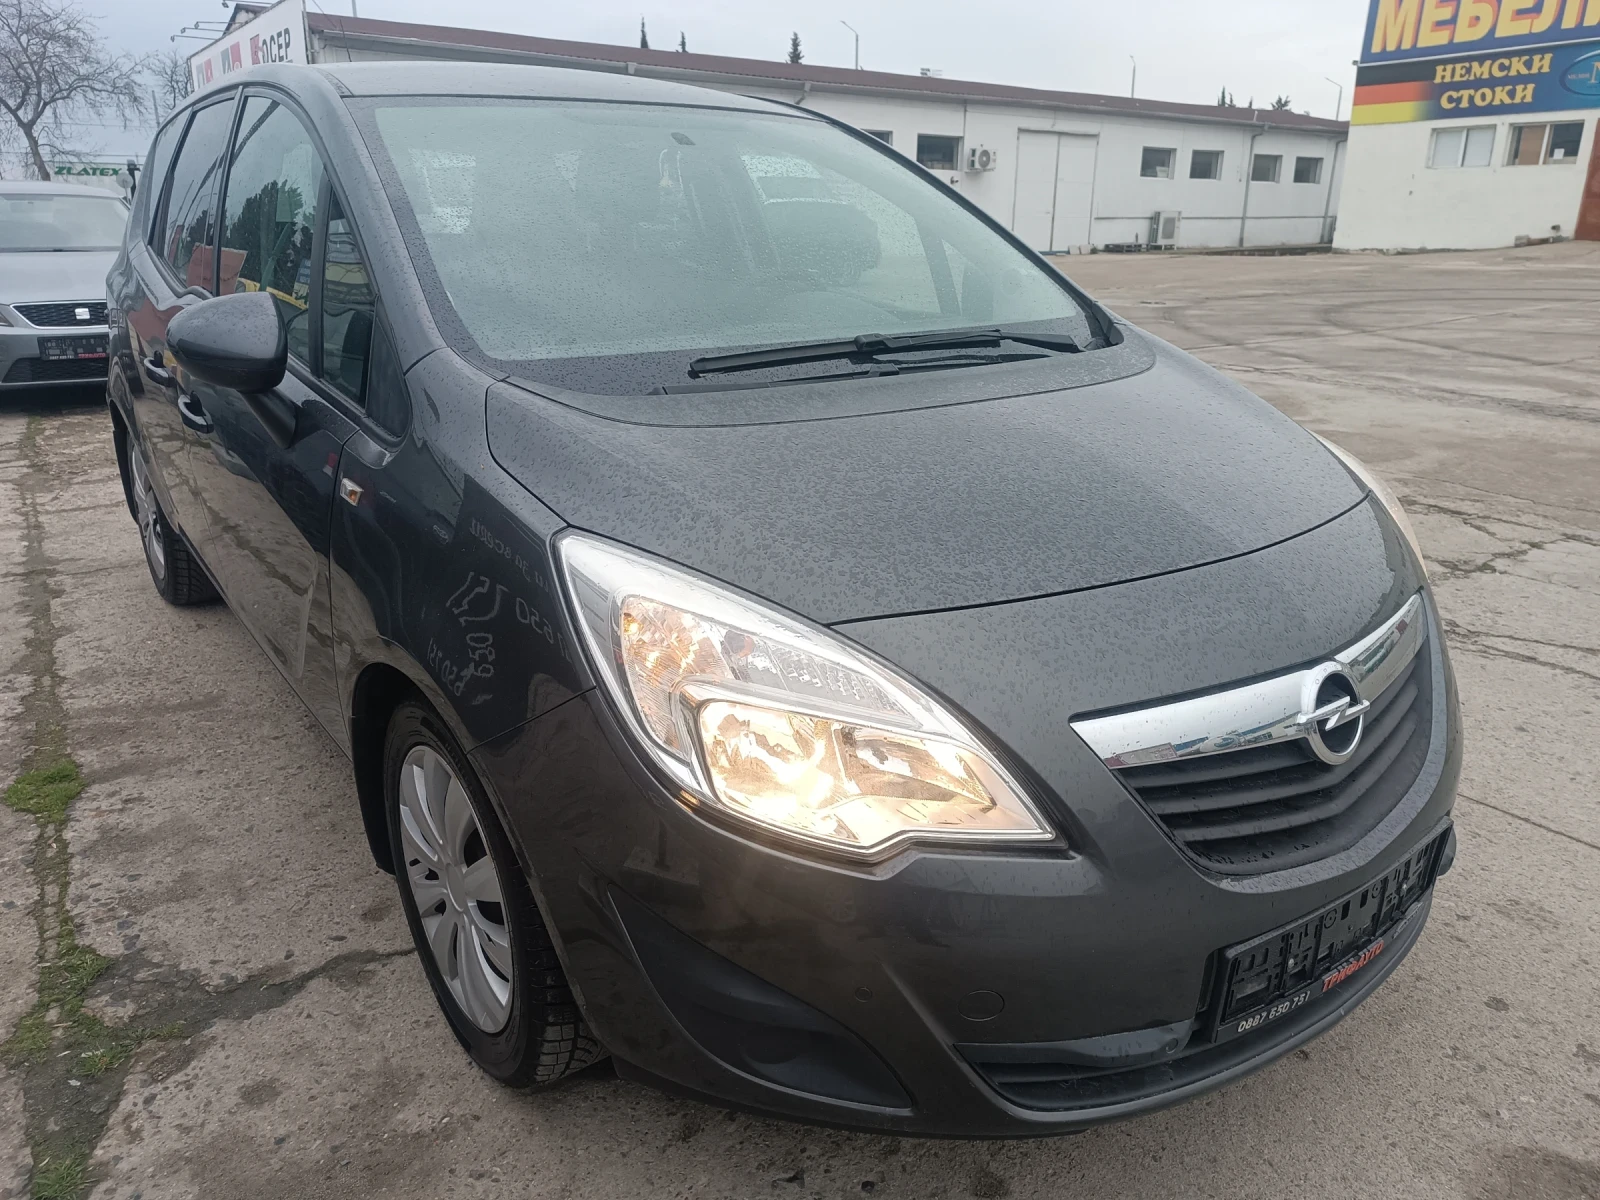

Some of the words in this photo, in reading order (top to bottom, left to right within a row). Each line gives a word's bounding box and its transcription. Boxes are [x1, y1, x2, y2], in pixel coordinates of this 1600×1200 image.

[1433, 53, 1553, 84] НЕМСКИ
[1440, 84, 1536, 109] СТОКИ
[55, 166, 122, 176] ZLATEX
[1237, 1011, 1267, 1032] 0887
[1269, 1002, 1290, 1019] 650
[1292, 990, 1310, 1009] 751
